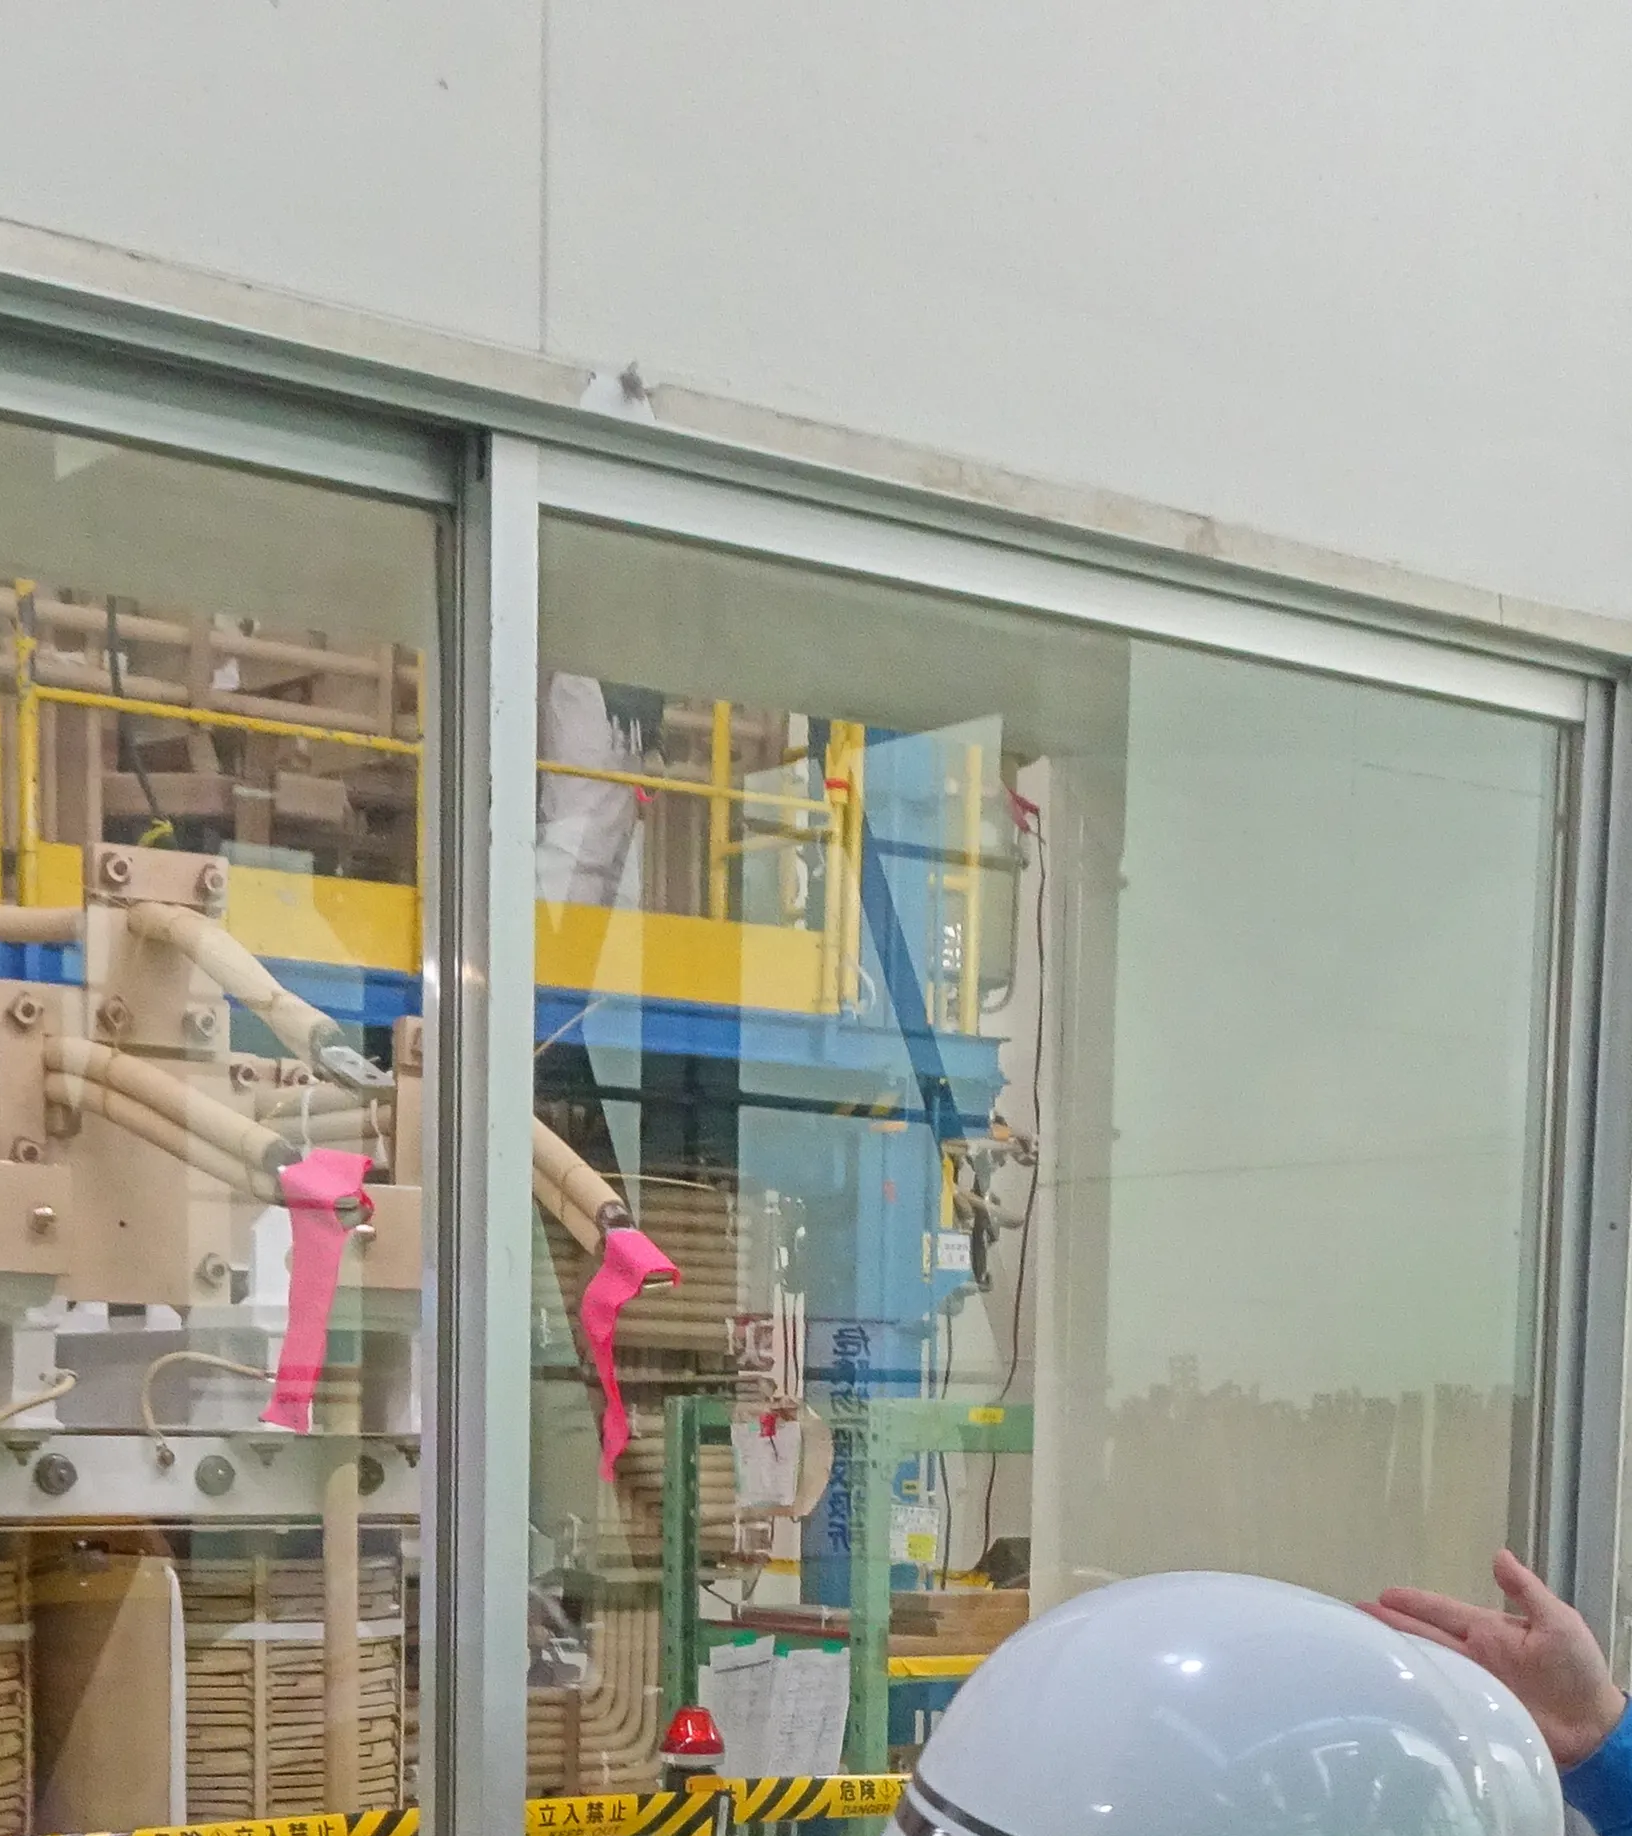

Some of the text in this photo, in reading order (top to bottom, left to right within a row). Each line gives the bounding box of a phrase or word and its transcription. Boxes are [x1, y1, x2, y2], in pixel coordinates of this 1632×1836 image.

[839, 1779, 876, 1802] 危険
[538, 1799, 627, 1827] 立入禁止
